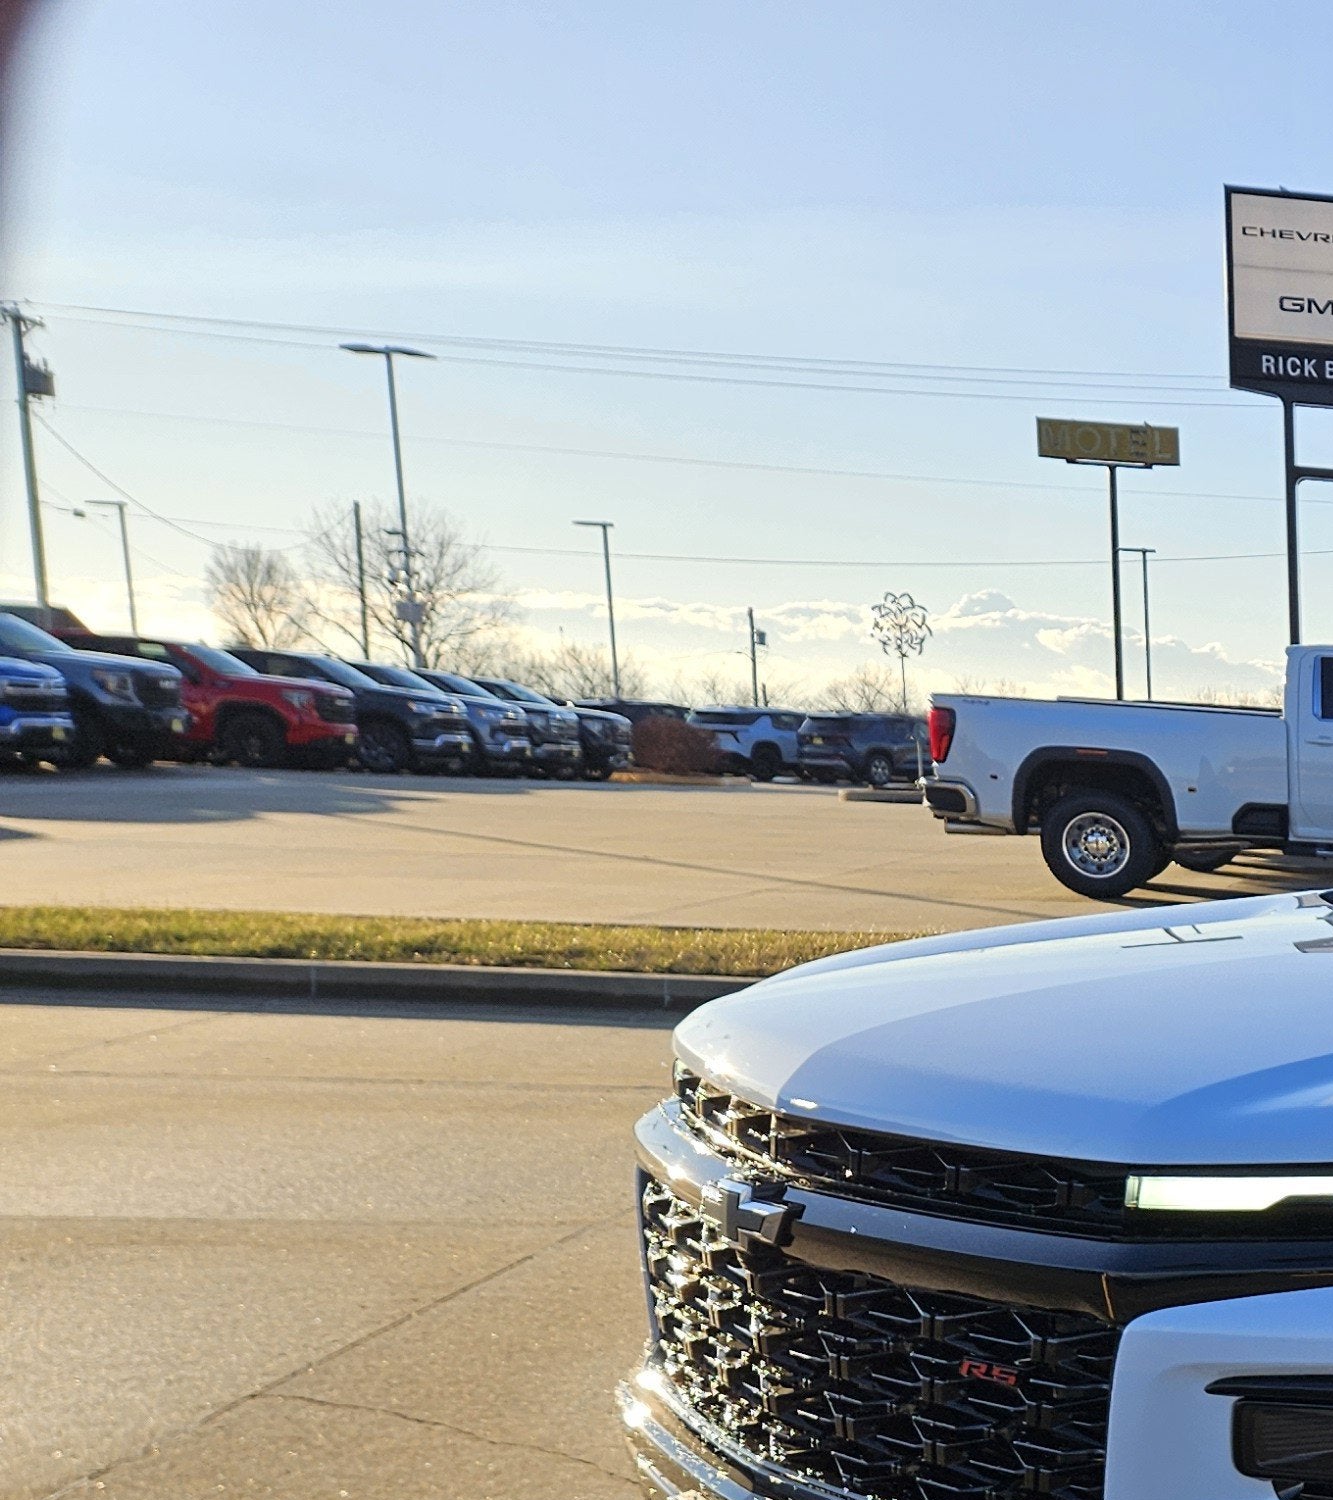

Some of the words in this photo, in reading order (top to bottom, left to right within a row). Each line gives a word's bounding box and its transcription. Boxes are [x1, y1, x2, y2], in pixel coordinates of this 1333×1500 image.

[1261, 354, 1319, 379] RICK
[1040, 424, 1173, 459] MOTEL
[959, 1360, 1018, 1387] RS
